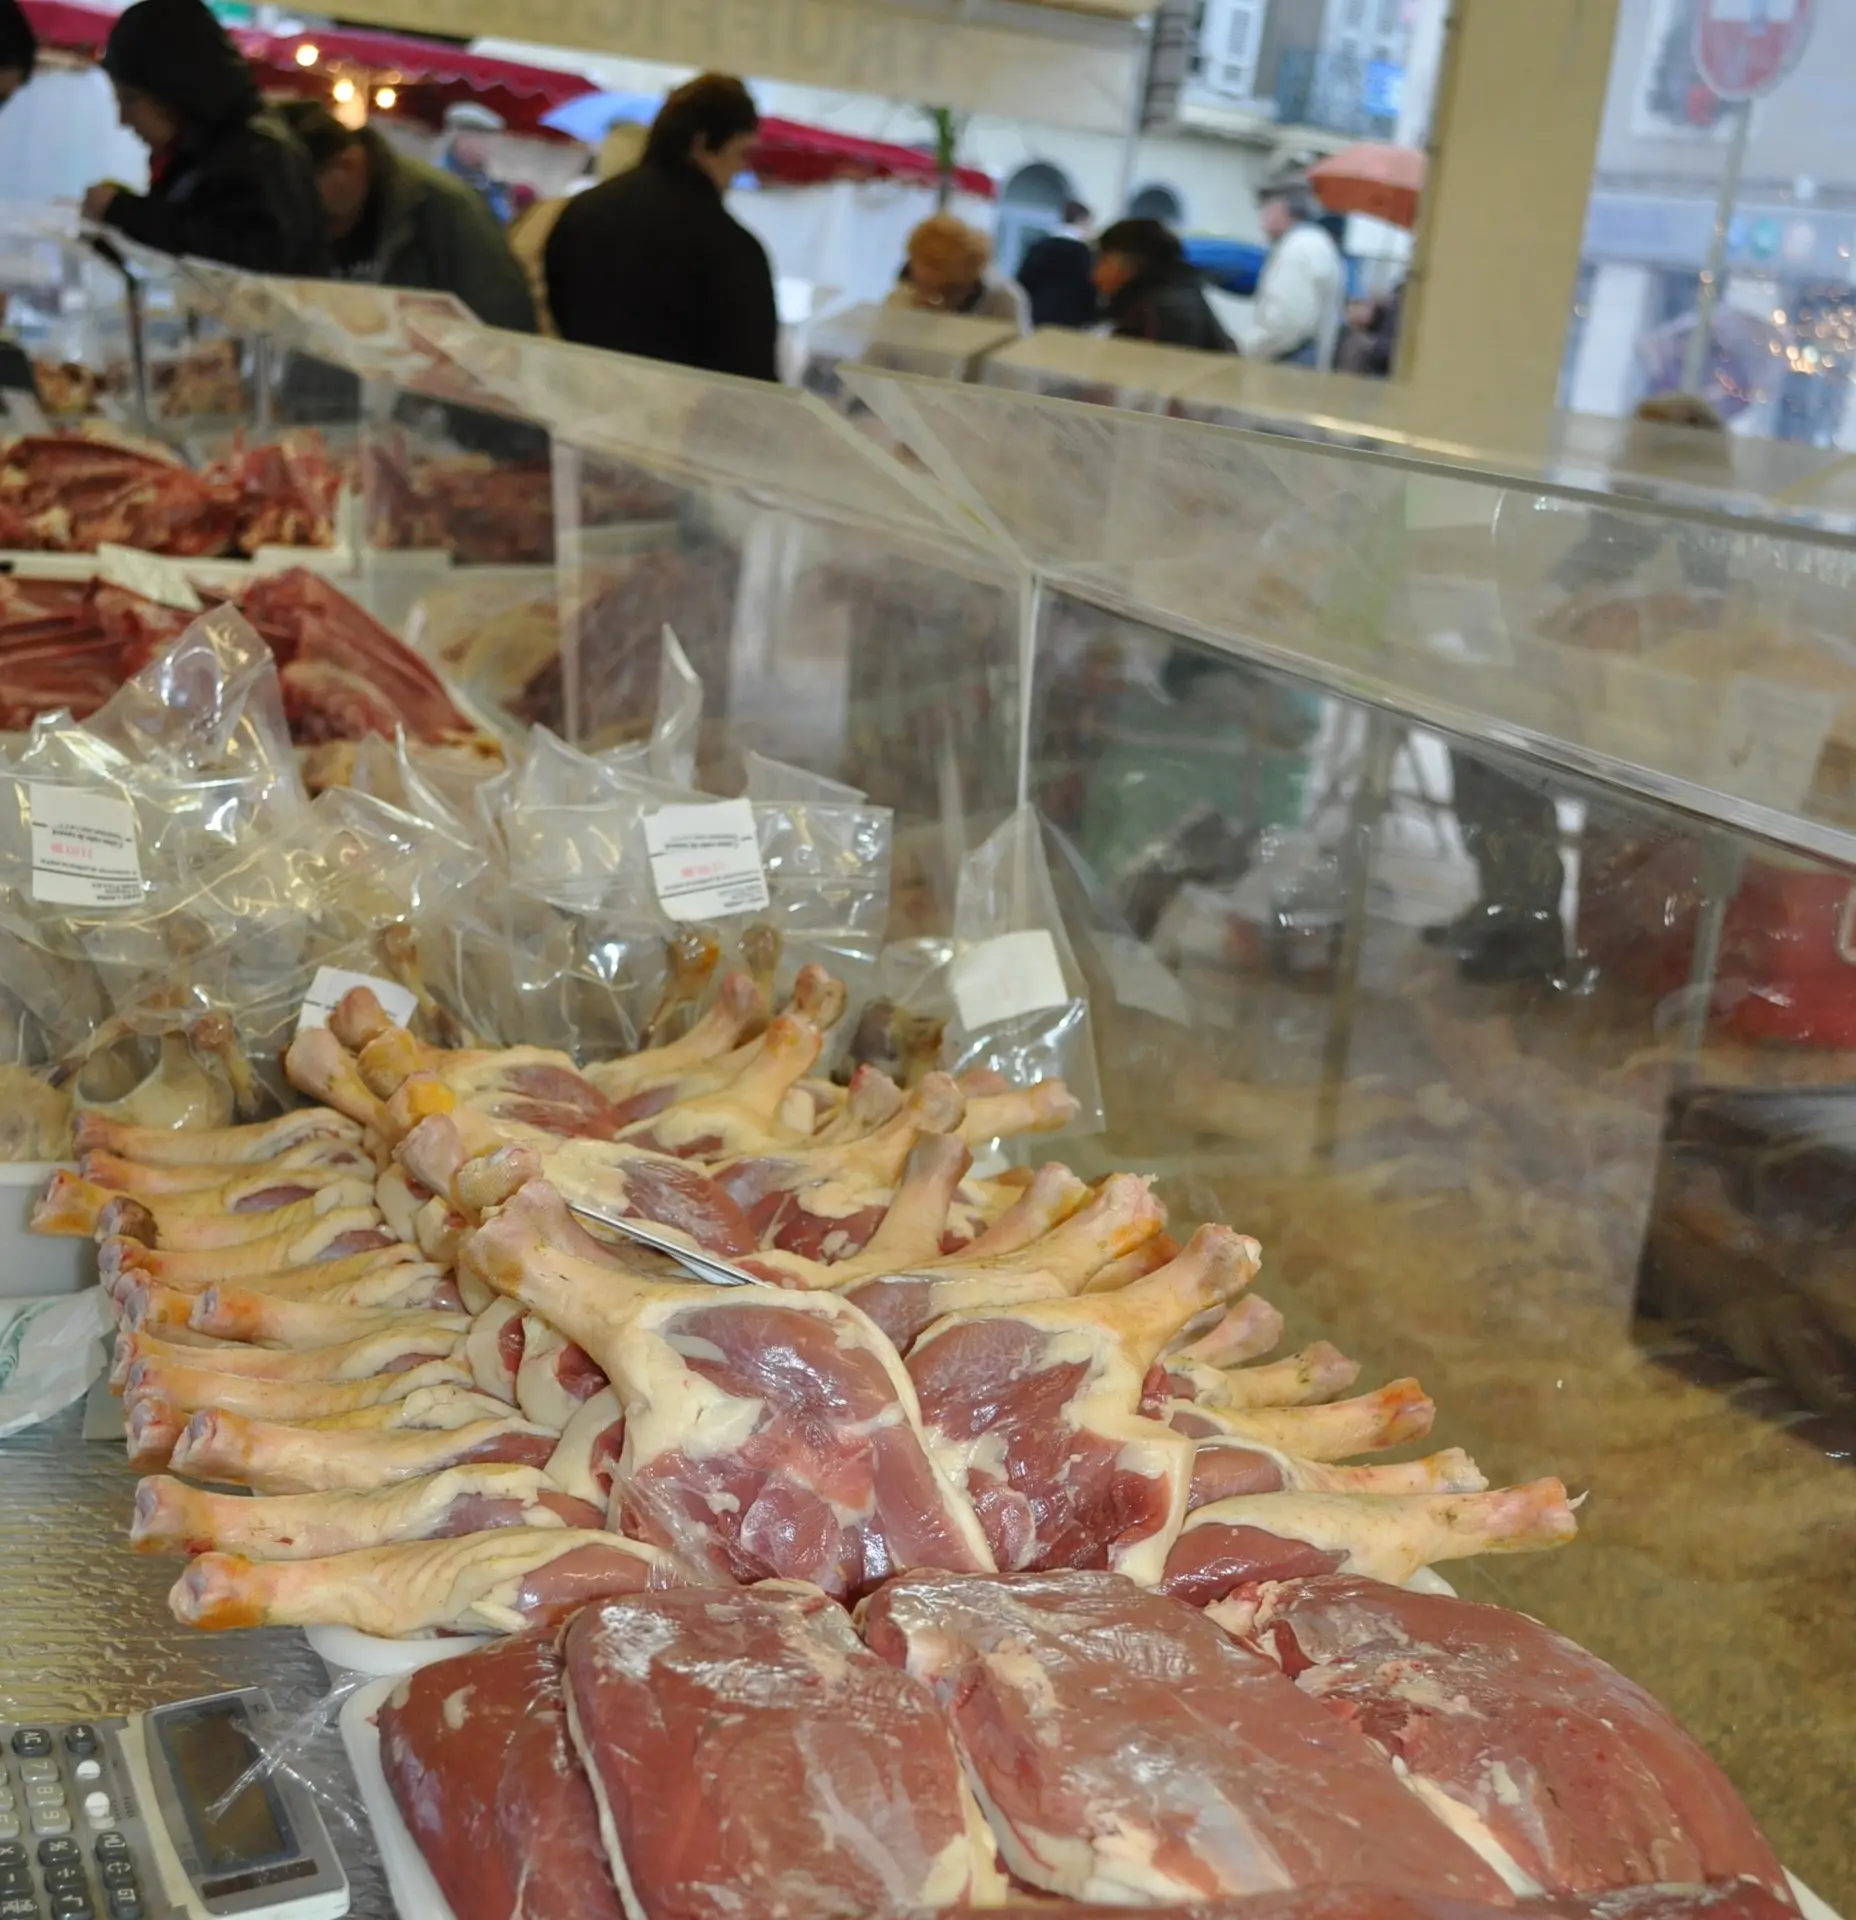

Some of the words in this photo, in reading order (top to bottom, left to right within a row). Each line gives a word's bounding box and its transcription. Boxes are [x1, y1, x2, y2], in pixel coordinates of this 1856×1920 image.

[23, 1732, 41, 1743] AC
[30, 1761, 48, 1770] 7
[37, 1786, 54, 1795] 8
[42, 1810, 60, 1820] 9
[118, 1888, 136, 1902] GT
